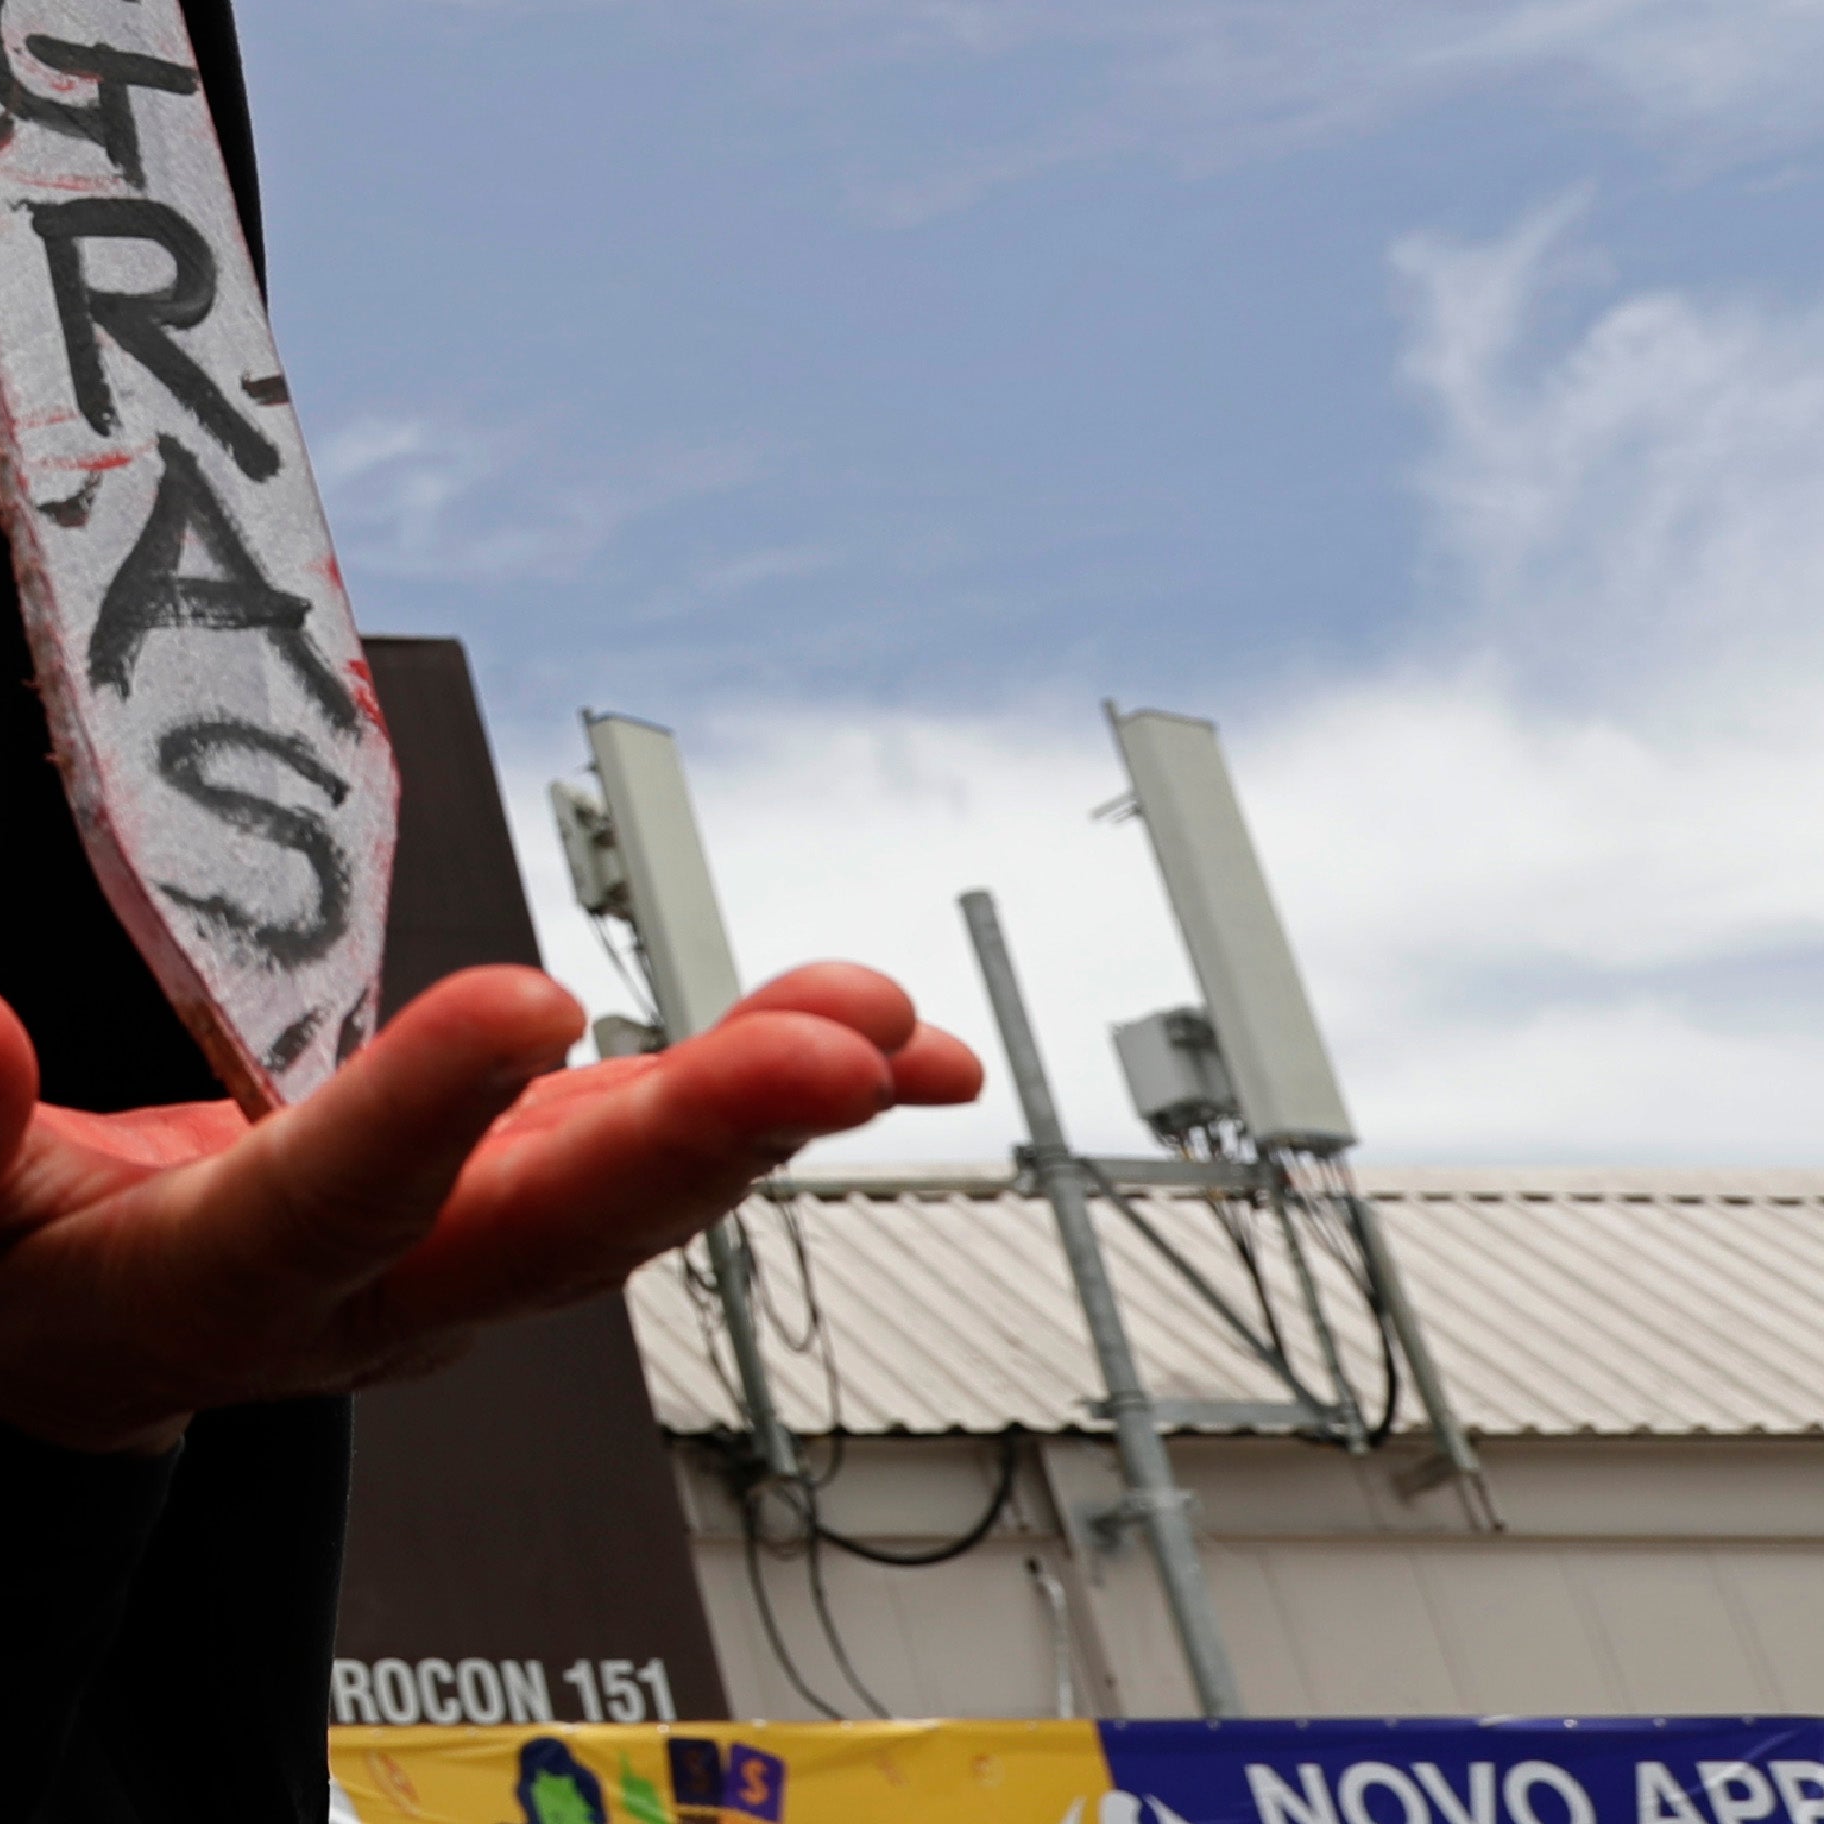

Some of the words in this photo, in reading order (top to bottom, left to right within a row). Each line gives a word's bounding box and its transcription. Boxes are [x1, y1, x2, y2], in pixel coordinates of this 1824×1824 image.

[333, 1657, 551, 1725] ROCON
[563, 1658, 677, 1723] 151
[1245, 1760, 1598, 1824] NOVO
